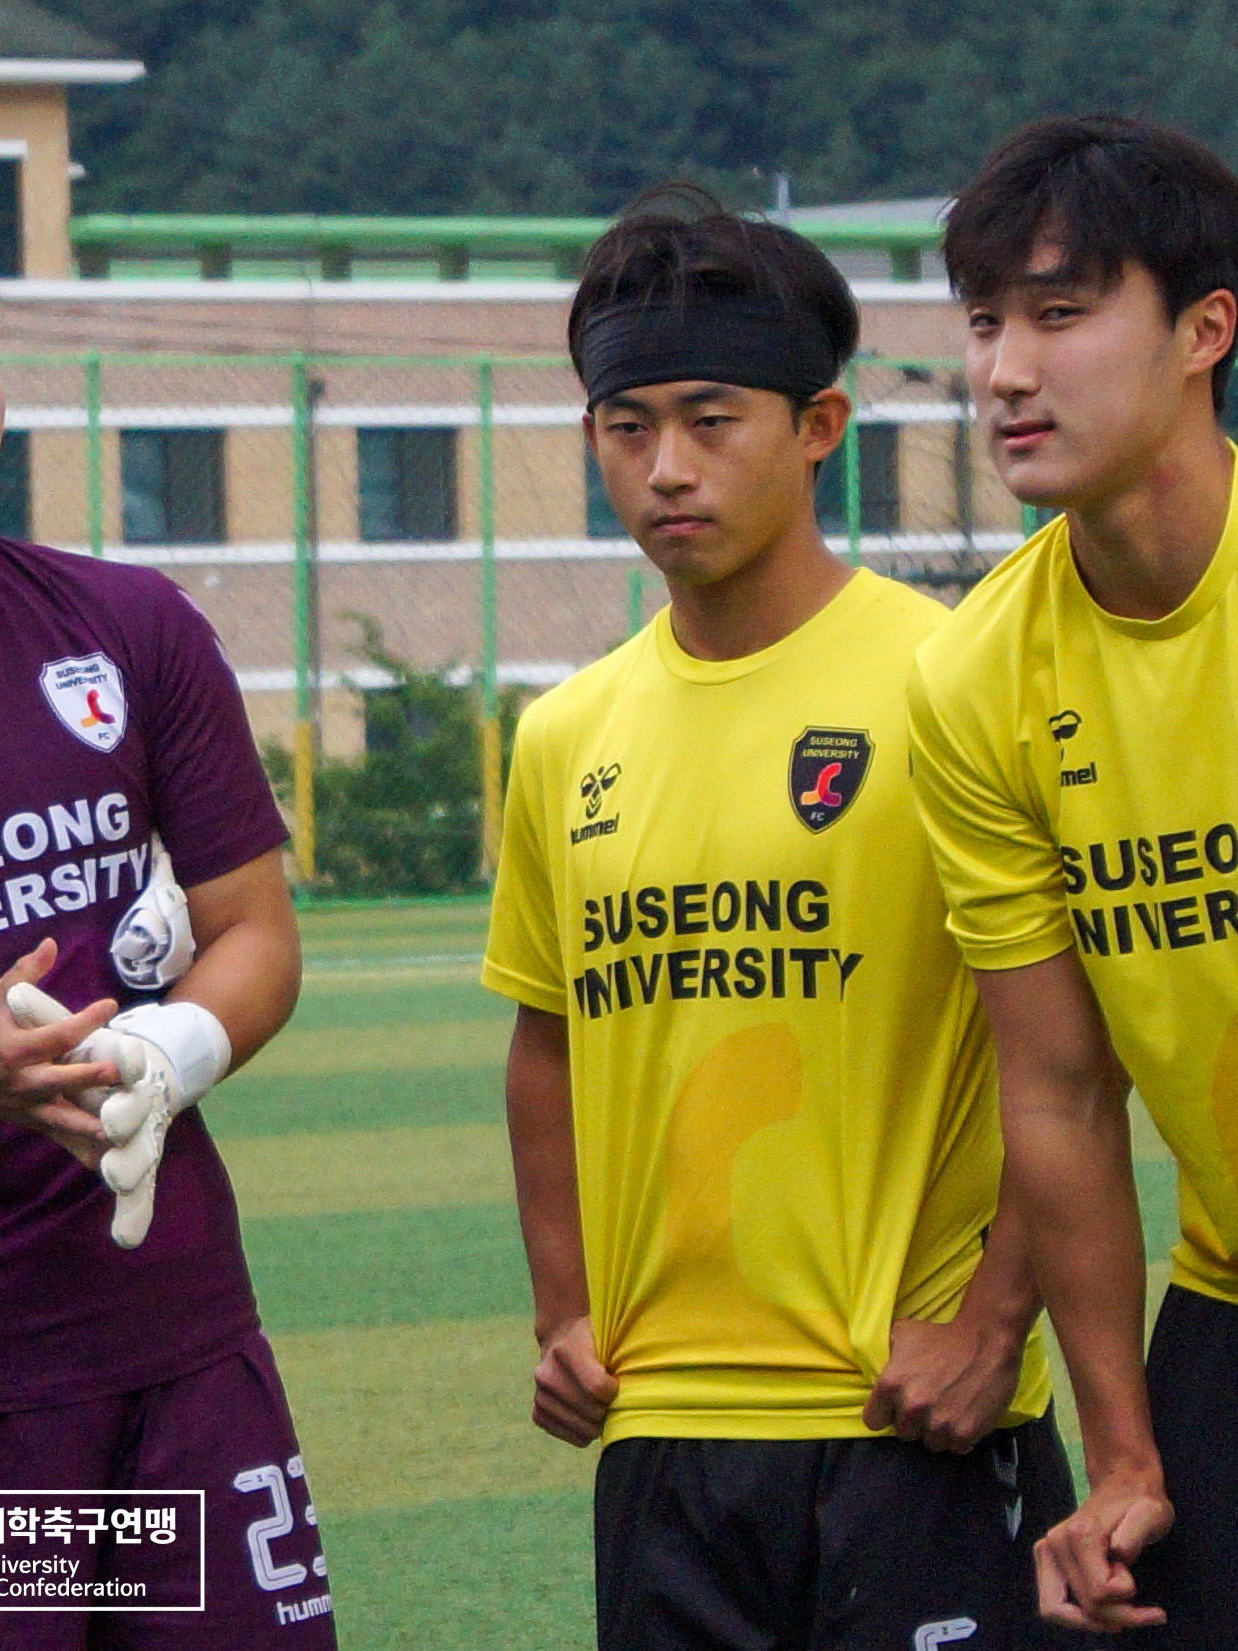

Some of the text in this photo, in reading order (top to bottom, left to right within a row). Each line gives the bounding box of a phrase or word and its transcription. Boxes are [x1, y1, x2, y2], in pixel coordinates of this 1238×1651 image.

[98, 732, 110, 740] FC
[809, 736, 858, 748] SUSEONG
[1061, 761, 1097, 787] mel
[810, 811, 825, 821] FC
[1060, 823, 1238, 895] SUSEO
[583, 880, 830, 952] SUSEONG
[276, 1594, 332, 1626] humm
